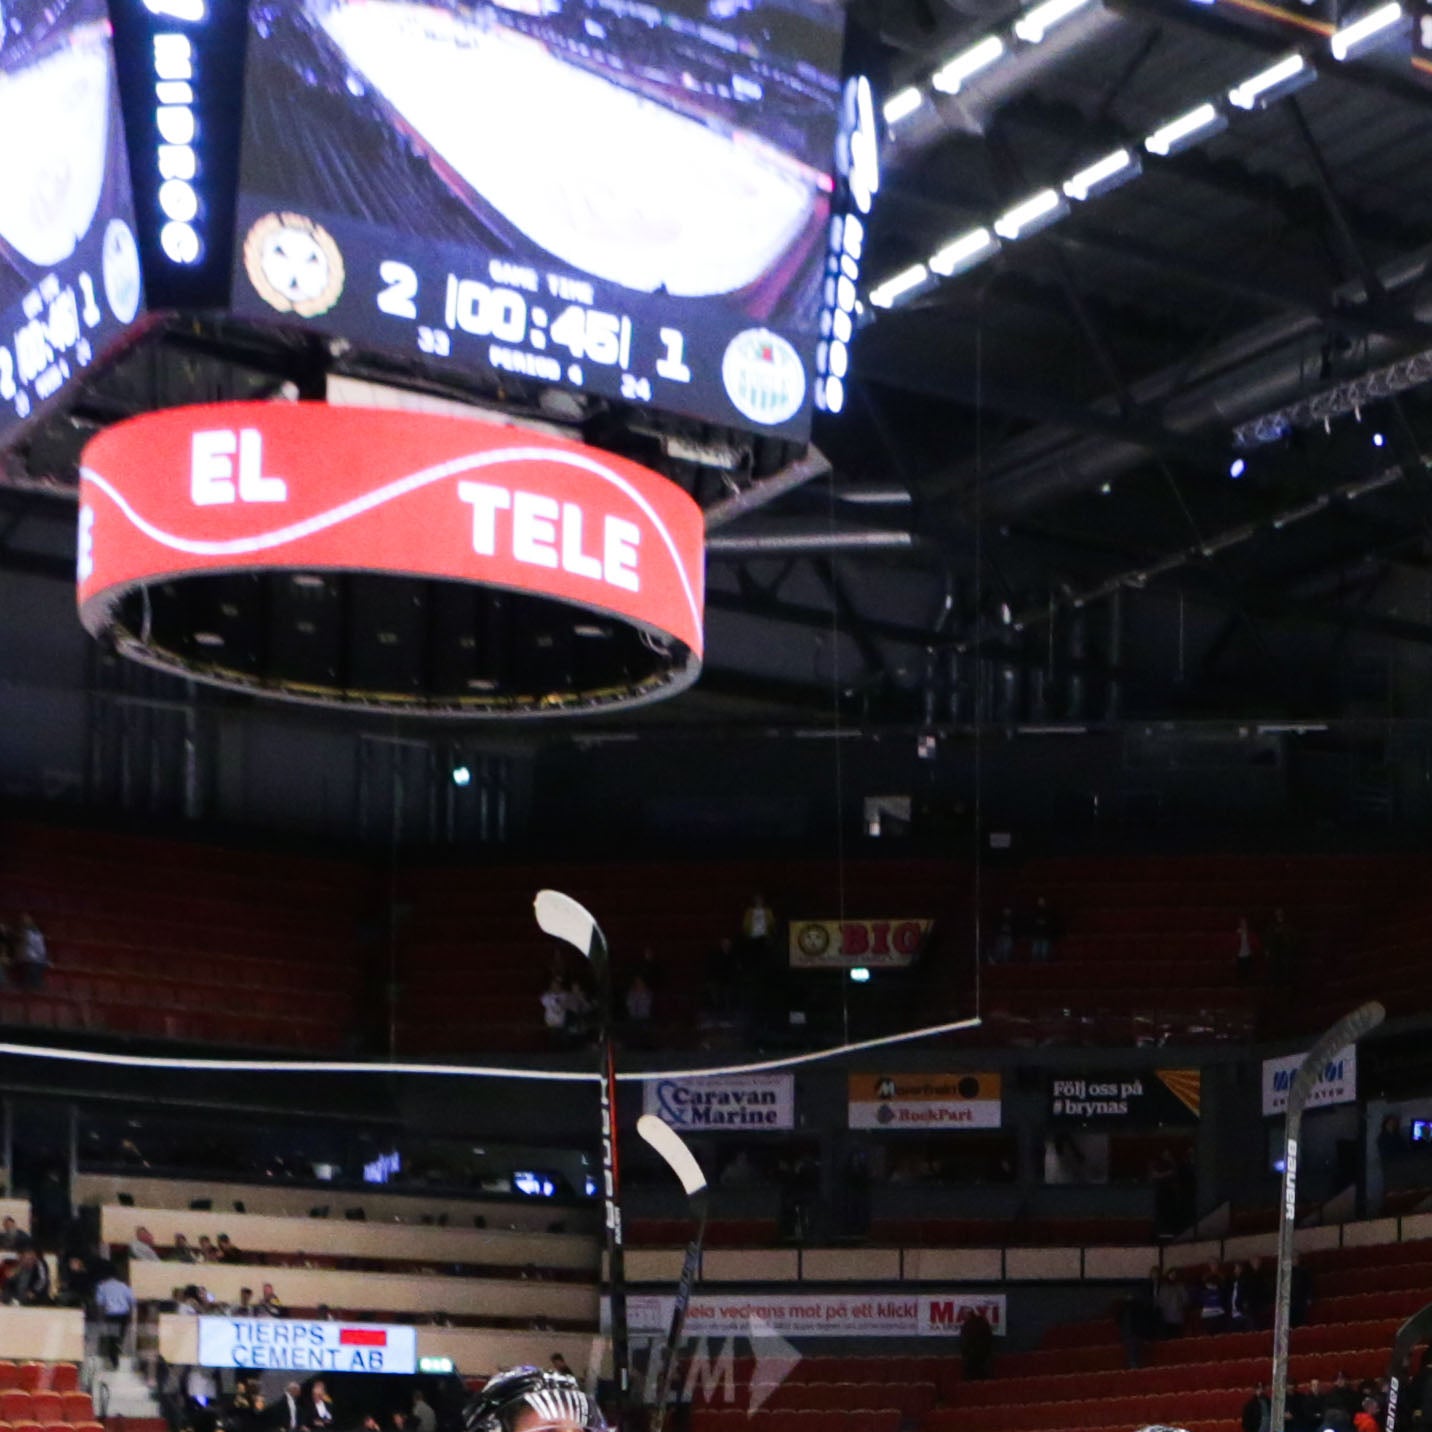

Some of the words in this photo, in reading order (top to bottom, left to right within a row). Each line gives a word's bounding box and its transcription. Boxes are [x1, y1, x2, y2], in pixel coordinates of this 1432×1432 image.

[377, 260, 418, 319] 2
[656, 327, 691, 382] 1
[190, 429, 288, 505] EL
[457, 482, 641, 592] TELE
[673, 1086, 776, 1105] Caravan
[1053, 1081, 1086, 1099] Följ
[1089, 1083, 1118, 1096] oss
[1121, 1080, 1143, 1097] på
[692, 1107, 777, 1124] Marine
[232, 1322, 324, 1346] TIERPS
[231, 1345, 341, 1370] CEMENT
[350, 1350, 384, 1370] AB
